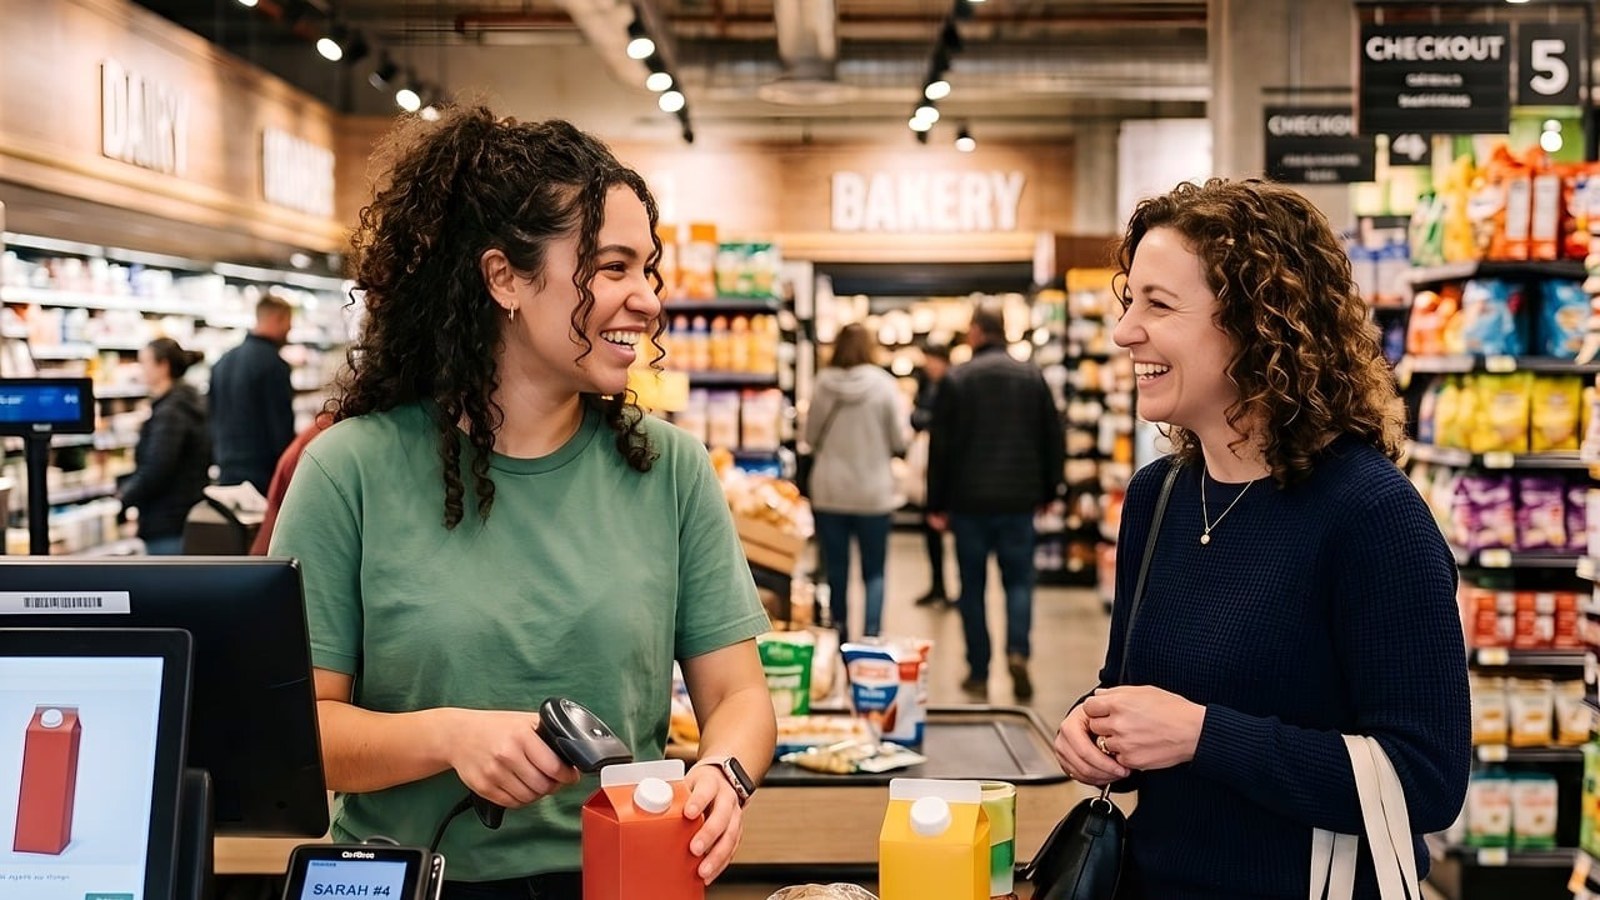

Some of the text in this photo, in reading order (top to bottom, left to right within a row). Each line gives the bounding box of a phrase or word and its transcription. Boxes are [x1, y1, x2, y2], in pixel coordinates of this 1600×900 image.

[1365, 36, 1504, 61] CHECKOUT
[1529, 39, 1569, 95] 5
[102, 60, 188, 176] DAIRY
[831, 171, 1025, 232] BAKERY
[313, 883, 390, 897] SARAH #4
